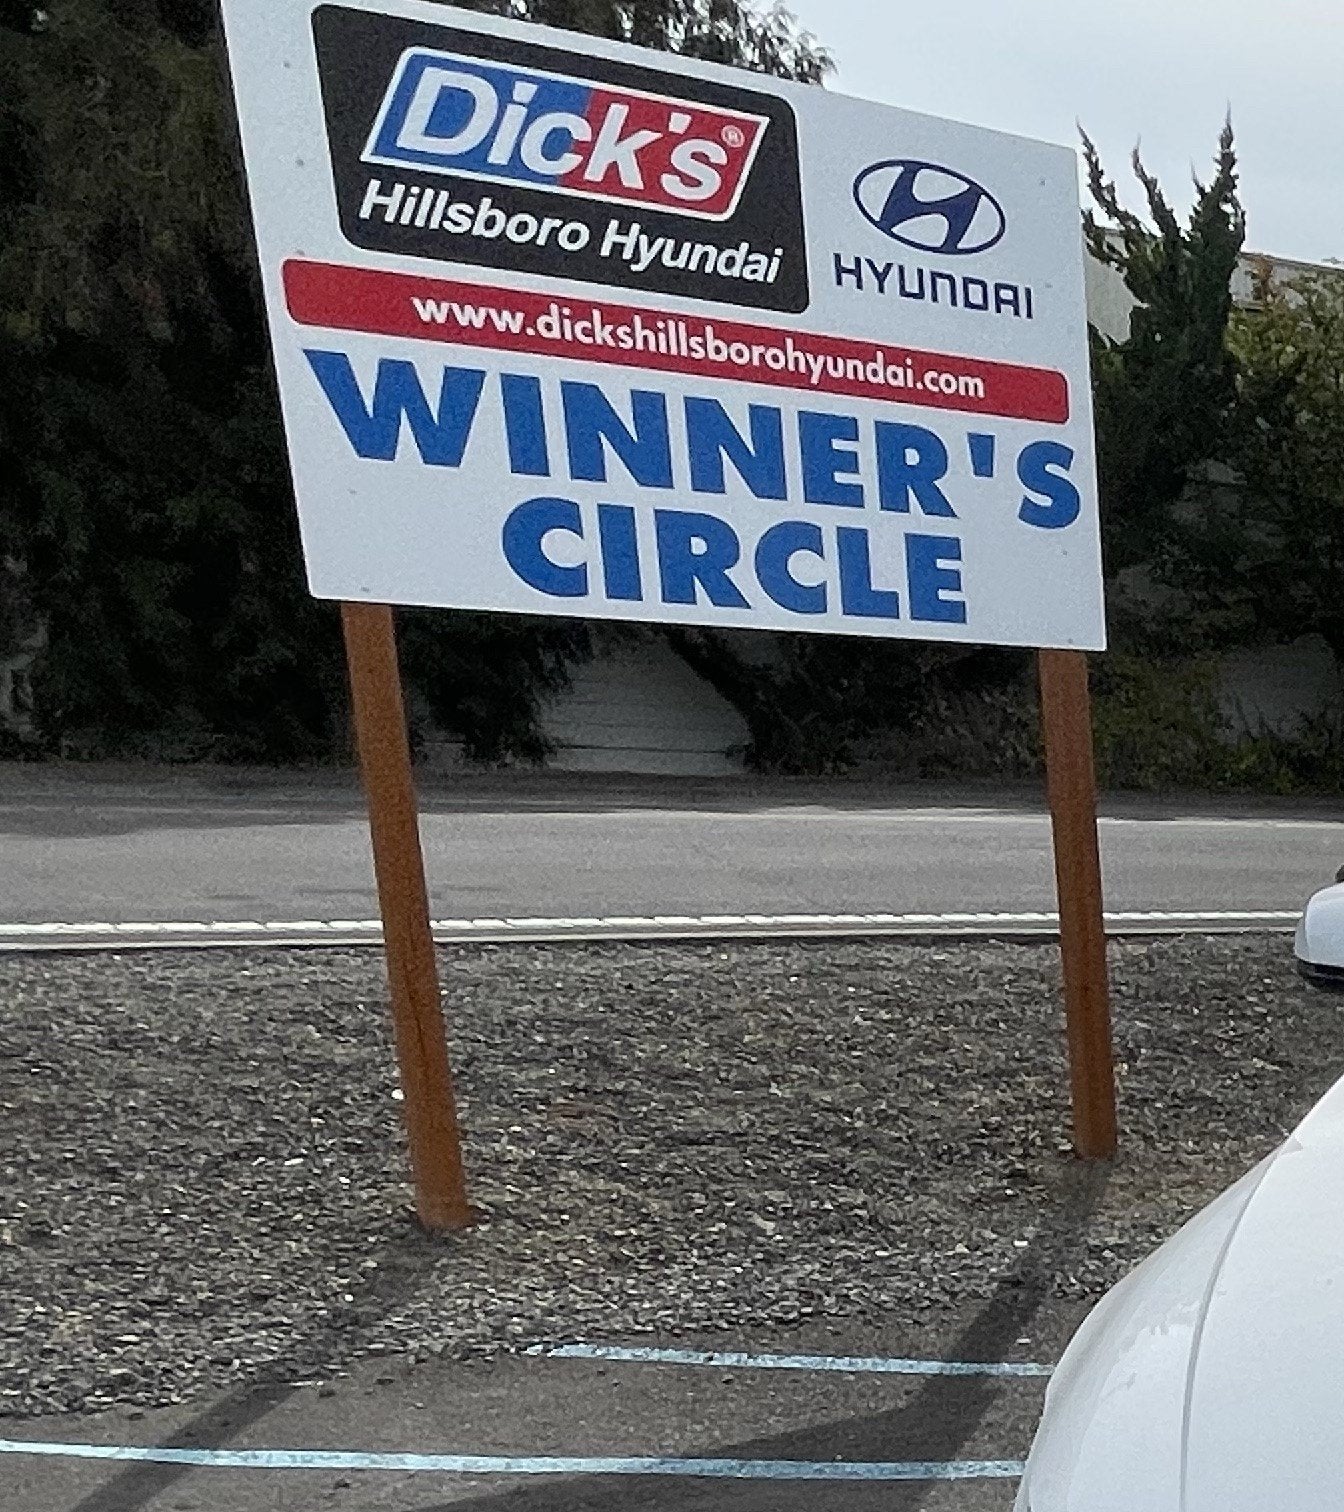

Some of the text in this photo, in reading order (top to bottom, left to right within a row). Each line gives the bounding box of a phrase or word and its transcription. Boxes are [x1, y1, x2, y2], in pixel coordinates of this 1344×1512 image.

[394, 65, 730, 203] Dick's
[360, 178, 785, 286] Hillsboro Hyundai
[834, 252, 1034, 320] HYUNDAI
[412, 291, 986, 400] www.dickshillsborohyundai.com
[302, 348, 1082, 529] WINNER'S
[501, 497, 968, 624] CIRCLE
